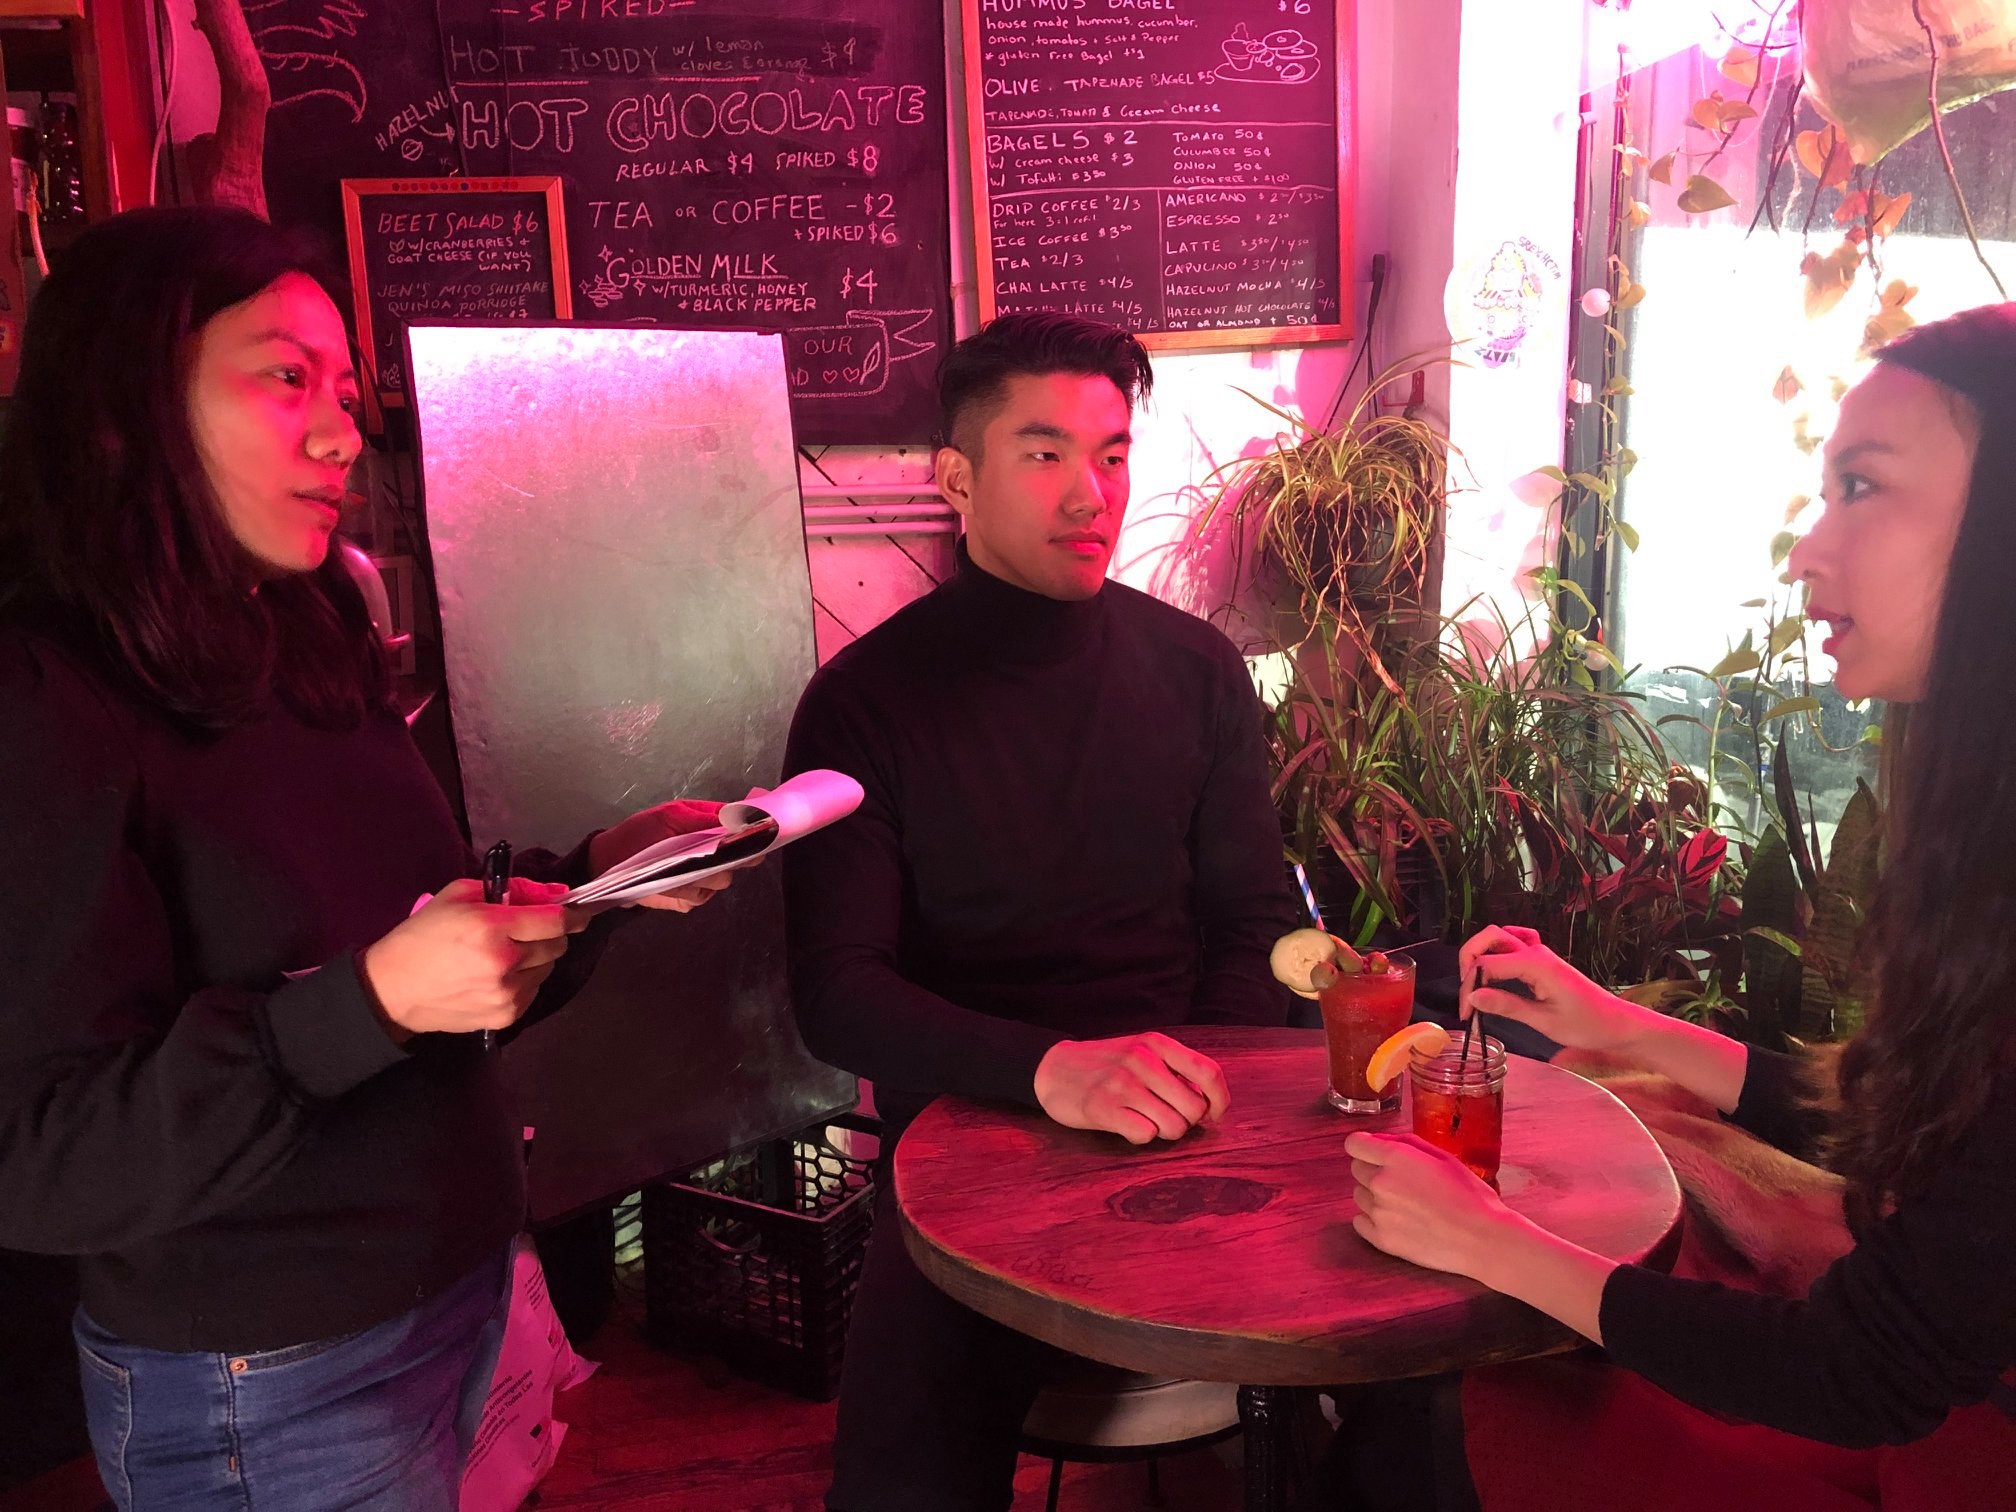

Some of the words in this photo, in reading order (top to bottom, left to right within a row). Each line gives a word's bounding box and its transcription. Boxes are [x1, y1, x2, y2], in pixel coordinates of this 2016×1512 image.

[986, 17, 1027, 30] house
[1034, 17, 1068, 29] made
[451, 36, 535, 73] HOT
[560, 43, 658, 75] TODDY
[998, 51, 1039, 66] gluten
[985, 78, 1040, 97] OLIVE
[1150, 73, 1194, 87] BAGEL
[375, 86, 459, 151] HAZELNUT
[463, 98, 589, 152] HOT
[607, 84, 927, 152] CHOCOLATE
[987, 130, 1090, 154] BAGELS
[1173, 132, 1224, 143] TOMATO
[616, 158, 710, 181] REGULAR
[728, 151, 752, 173] $4
[776, 152, 836, 170] SPIKED
[847, 145, 878, 172] $8
[1015, 158, 1052, 168] cream
[1058, 152, 1099, 165] cheese
[1174, 161, 1216, 170] ONION
[1173, 175, 1214, 184] GLUTEN
[1166, 192, 1246, 207] AMERICANO
[589, 201, 653, 228] TEA
[676, 206, 697, 219] OR
[712, 194, 826, 225] COFFEE
[992, 203, 1033, 217] DRIP
[1041, 199, 1099, 214] COFFEE
[378, 213, 438, 234] BEET
[444, 213, 504, 239] SALAD
[512, 210, 539, 236] $6
[1014, 219, 1036, 227] here
[1166, 215, 1241, 227] ESPRESSO
[808, 225, 864, 242] SPIKED
[868, 222, 897, 244] $6
[993, 236, 1026, 248] ICE
[1039, 232, 1089, 246] COFFEE
[1166, 240, 1221, 254] LATTE
[388, 253, 422, 264] GOAT
[428, 251, 472, 262] CHEESE
[504, 251, 531, 261] YOU
[995, 257, 1030, 271] TEA
[605, 254, 702, 288] GOLDEN
[711, 252, 778, 282] MILK
[840, 267, 878, 304] $4
[377, 282, 431, 297] JEN'S
[439, 284, 482, 297] MISO
[758, 282, 808, 296] HONEY
[996, 281, 1032, 294] CHAI
[1040, 280, 1088, 292] LATTE
[1166, 283, 1231, 296] HAZELNUT
[1237, 282, 1282, 292] MOCHA
[388, 300, 451, 318] QUINOA
[459, 295, 526, 313] PORRIDGE
[693, 298, 748, 312] BLACK
[754, 297, 817, 312] PEPPER
[1065, 303, 1105, 315] LATTE
[1167, 305, 1228, 318] HAZELNUT
[804, 335, 852, 355] OUR
